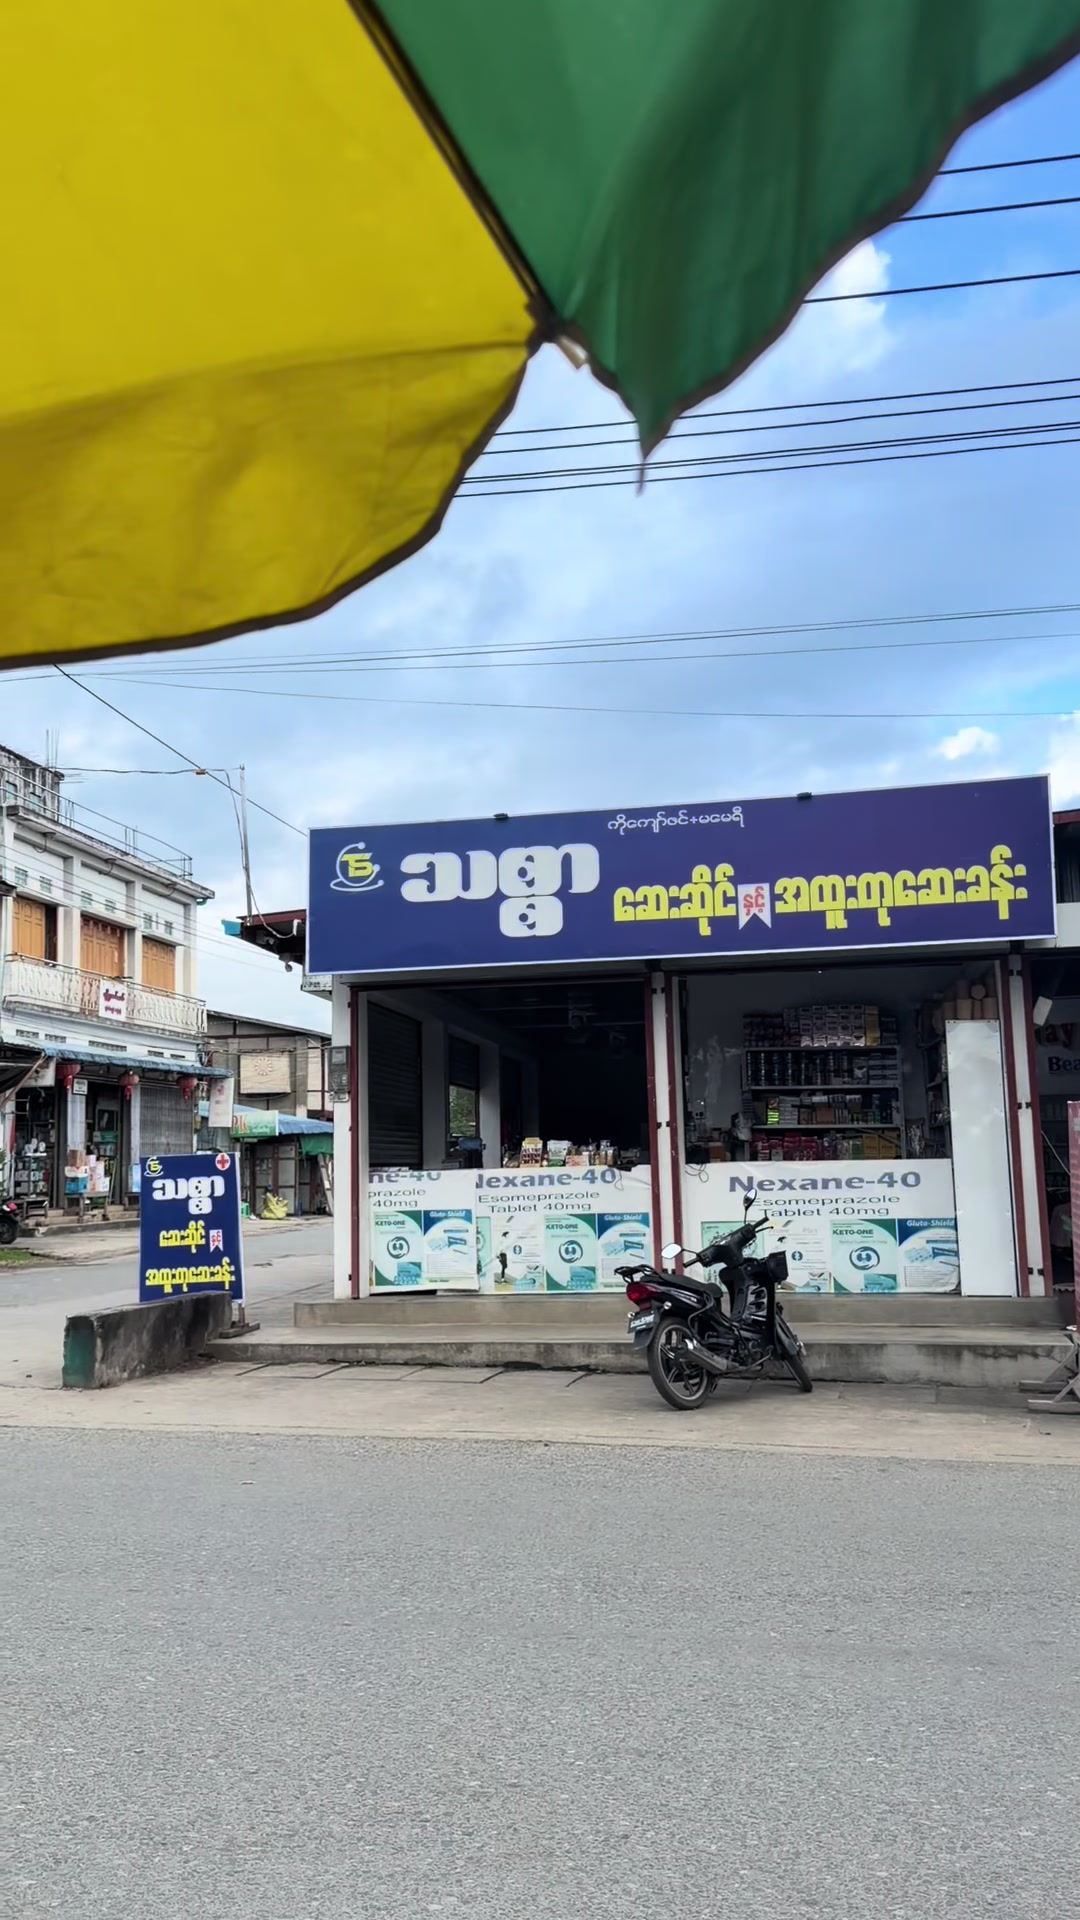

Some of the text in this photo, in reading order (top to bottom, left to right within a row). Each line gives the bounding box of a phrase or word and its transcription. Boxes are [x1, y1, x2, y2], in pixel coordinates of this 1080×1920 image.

[400, 843, 600, 938] သစ္စာ
[613, 863, 737, 936] ဆေးဆိုင်
[774, 844, 1028, 930] အထူးကုဆေးခန်း
[729, 1171, 921, 1193] Nexane-40
[478, 1191, 600, 1203] Esomeprazole
[751, 1195, 900, 1207] Esomeprazole
[373, 1199, 418, 1208] 40mg
[487, 1202, 592, 1214] Tablet 40mg
[758, 1207, 890, 1217] Tablet 40mg
[832, 1228, 874, 1236] KETO-ONE
